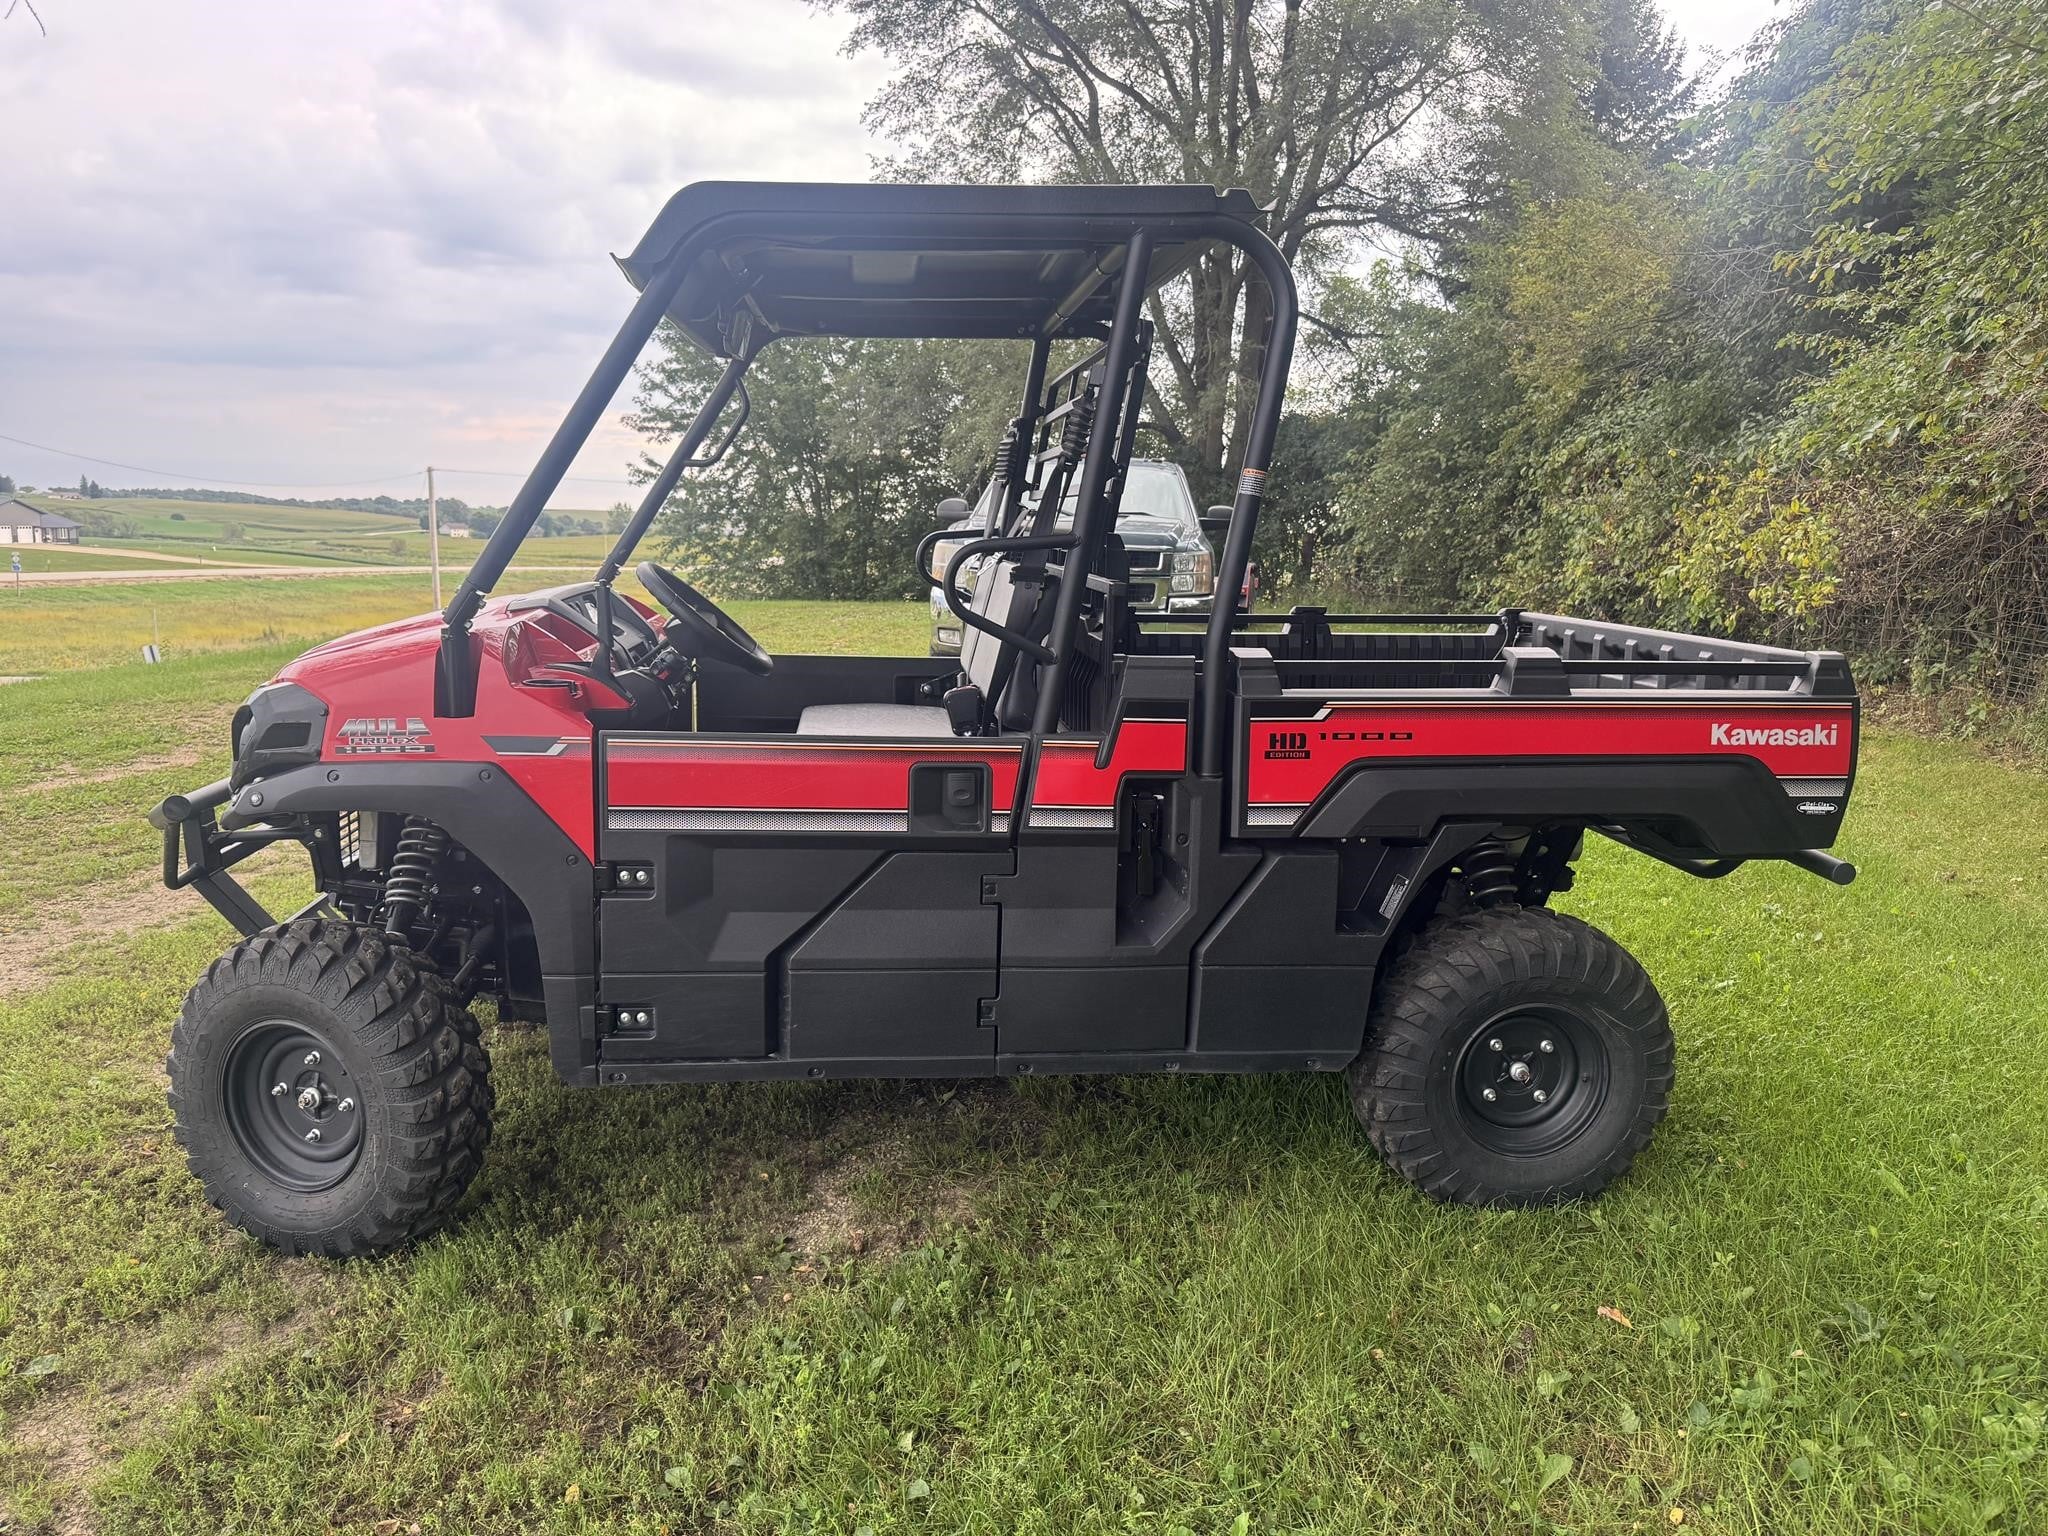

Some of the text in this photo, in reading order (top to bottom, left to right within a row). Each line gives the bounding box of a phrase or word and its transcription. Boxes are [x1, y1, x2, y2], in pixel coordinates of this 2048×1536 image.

[337, 717, 432, 737] MULE
[1711, 723, 1838, 746] Kawasaki
[344, 745, 427, 754] 1000
[1269, 732, 1413, 749] HD 1000
